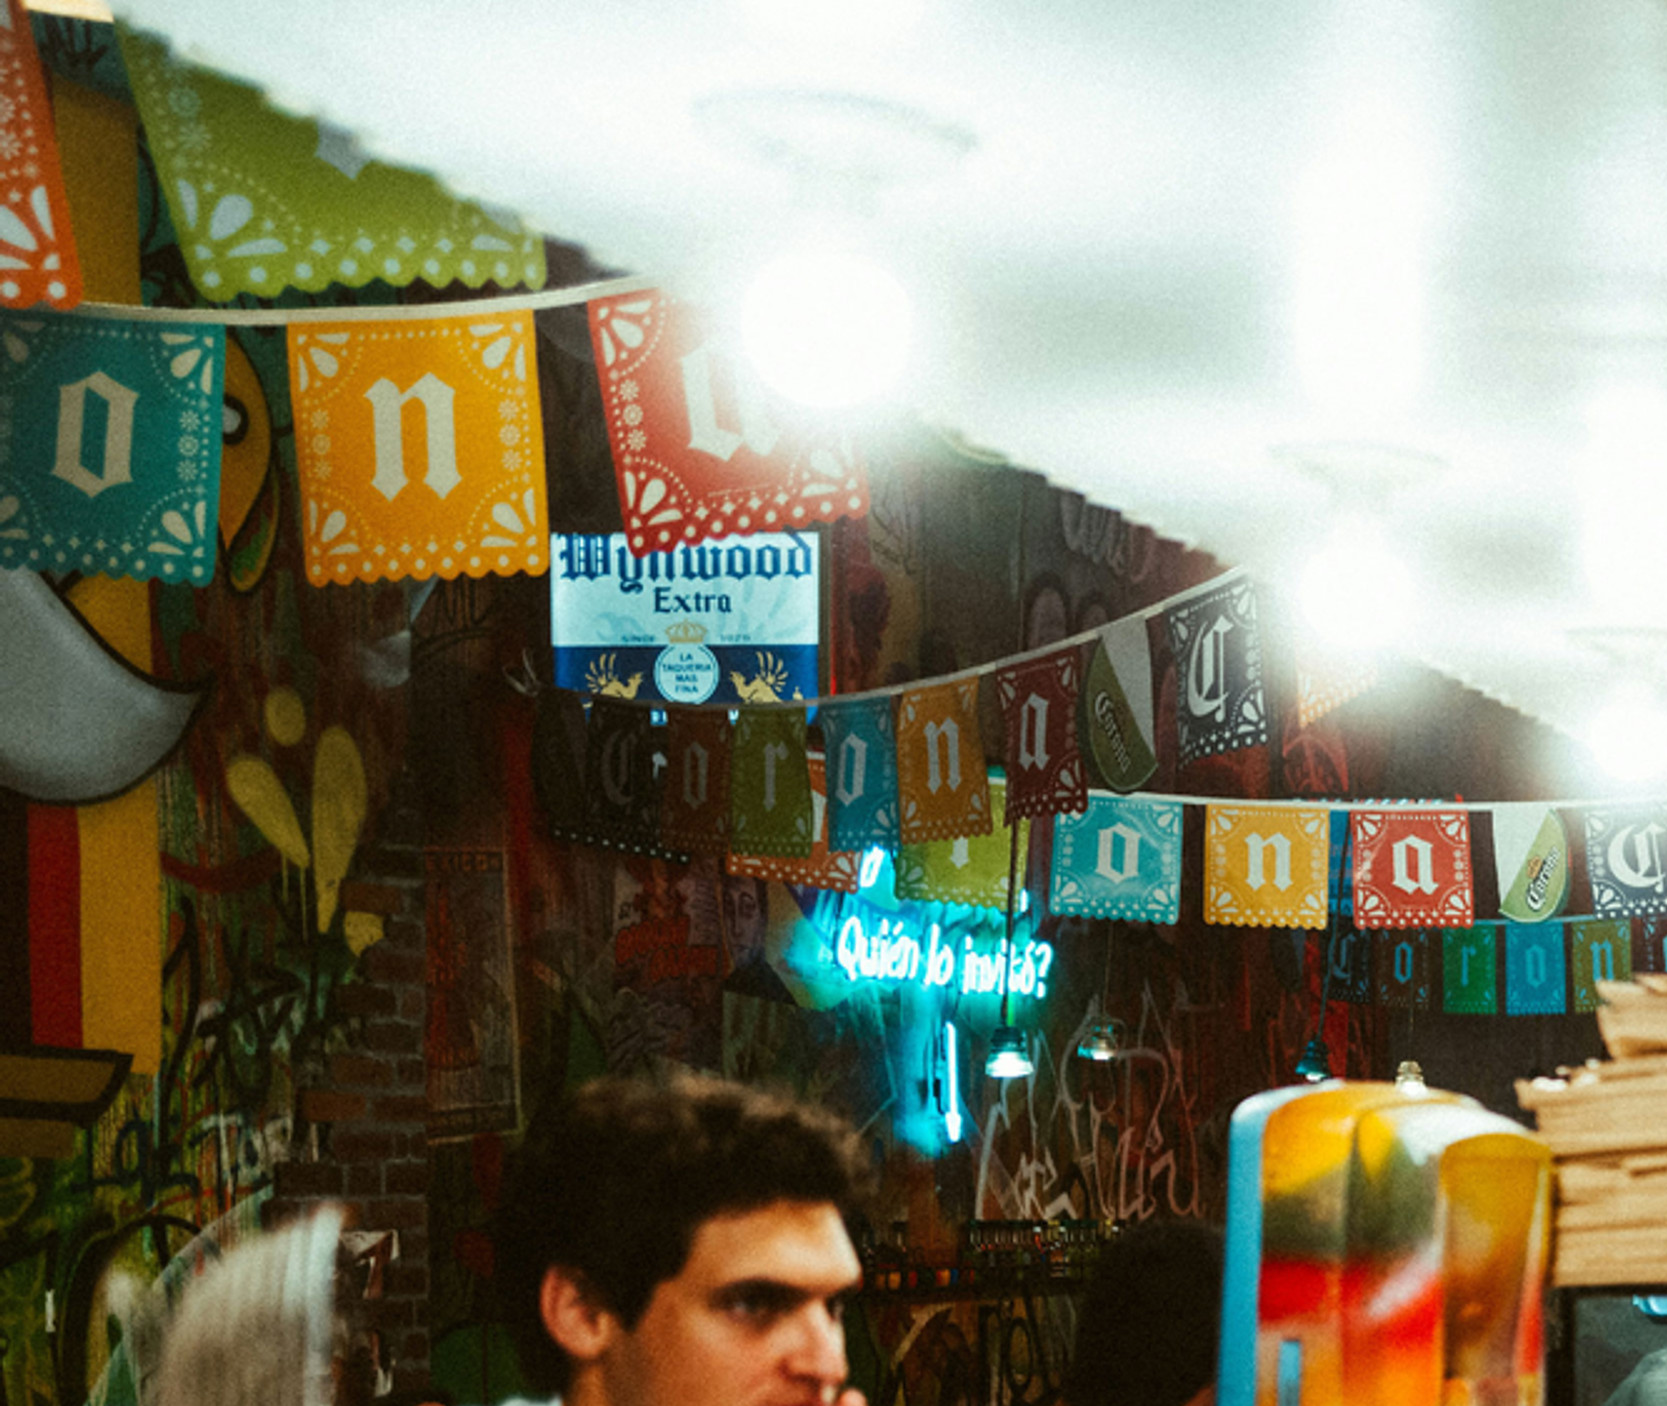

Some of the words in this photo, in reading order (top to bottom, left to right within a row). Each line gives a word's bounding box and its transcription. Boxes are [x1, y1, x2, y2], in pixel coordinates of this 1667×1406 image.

[557, 533, 812, 594] Wynwood
[652, 586, 732, 614] Extra
[679, 652, 694, 662] LA
[923, 922, 955, 986] lo
